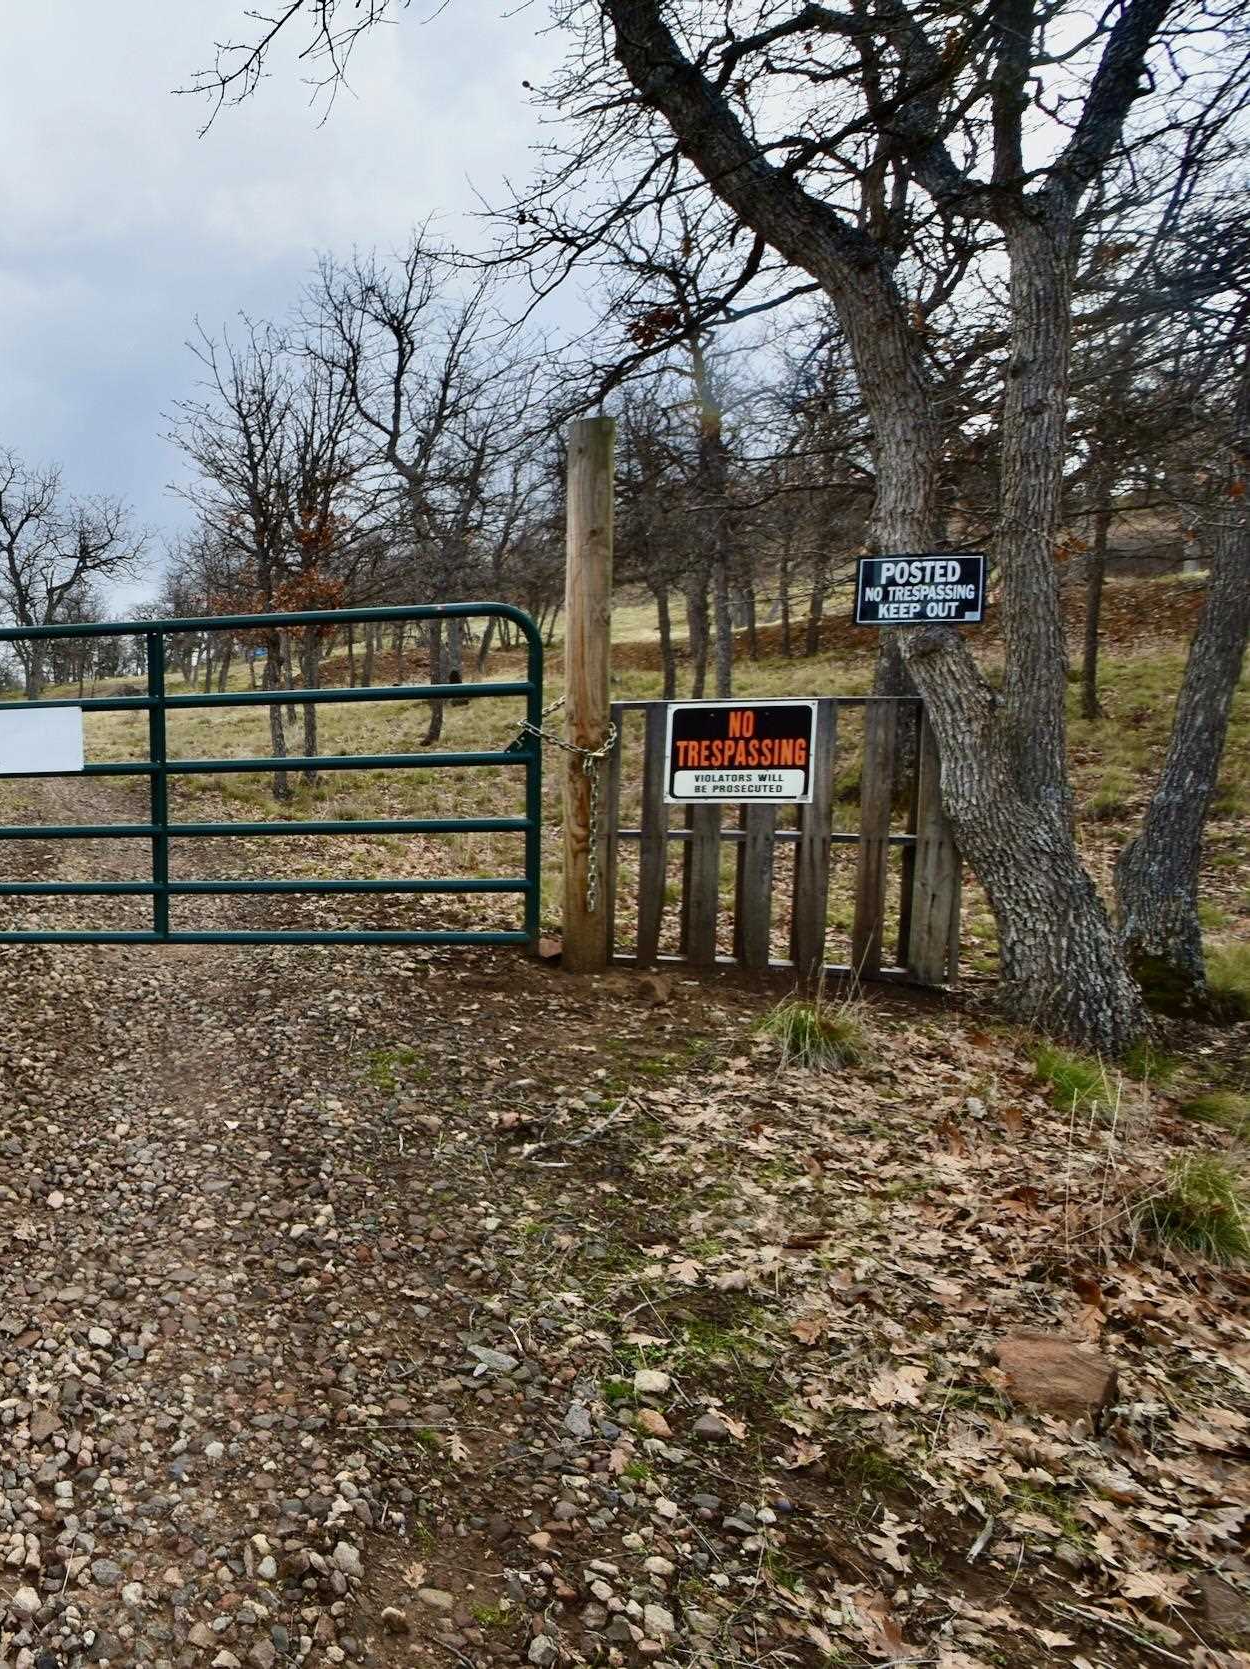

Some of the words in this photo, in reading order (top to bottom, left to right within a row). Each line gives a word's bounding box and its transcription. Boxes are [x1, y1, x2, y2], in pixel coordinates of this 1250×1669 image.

[880, 561, 961, 584] POSTED
[865, 587, 883, 601] NO
[888, 584, 975, 601] TRESPASSING
[878, 603, 920, 618] KEEP
[926, 602, 959, 617] OUT
[729, 711, 754, 737] NO
[677, 739, 806, 767] TRESPASSING
[694, 774, 752, 783] VIOLATORS
[758, 774, 784, 782] WILL
[694, 785, 707, 793] BE
[712, 785, 783, 793] PROSECUTED
